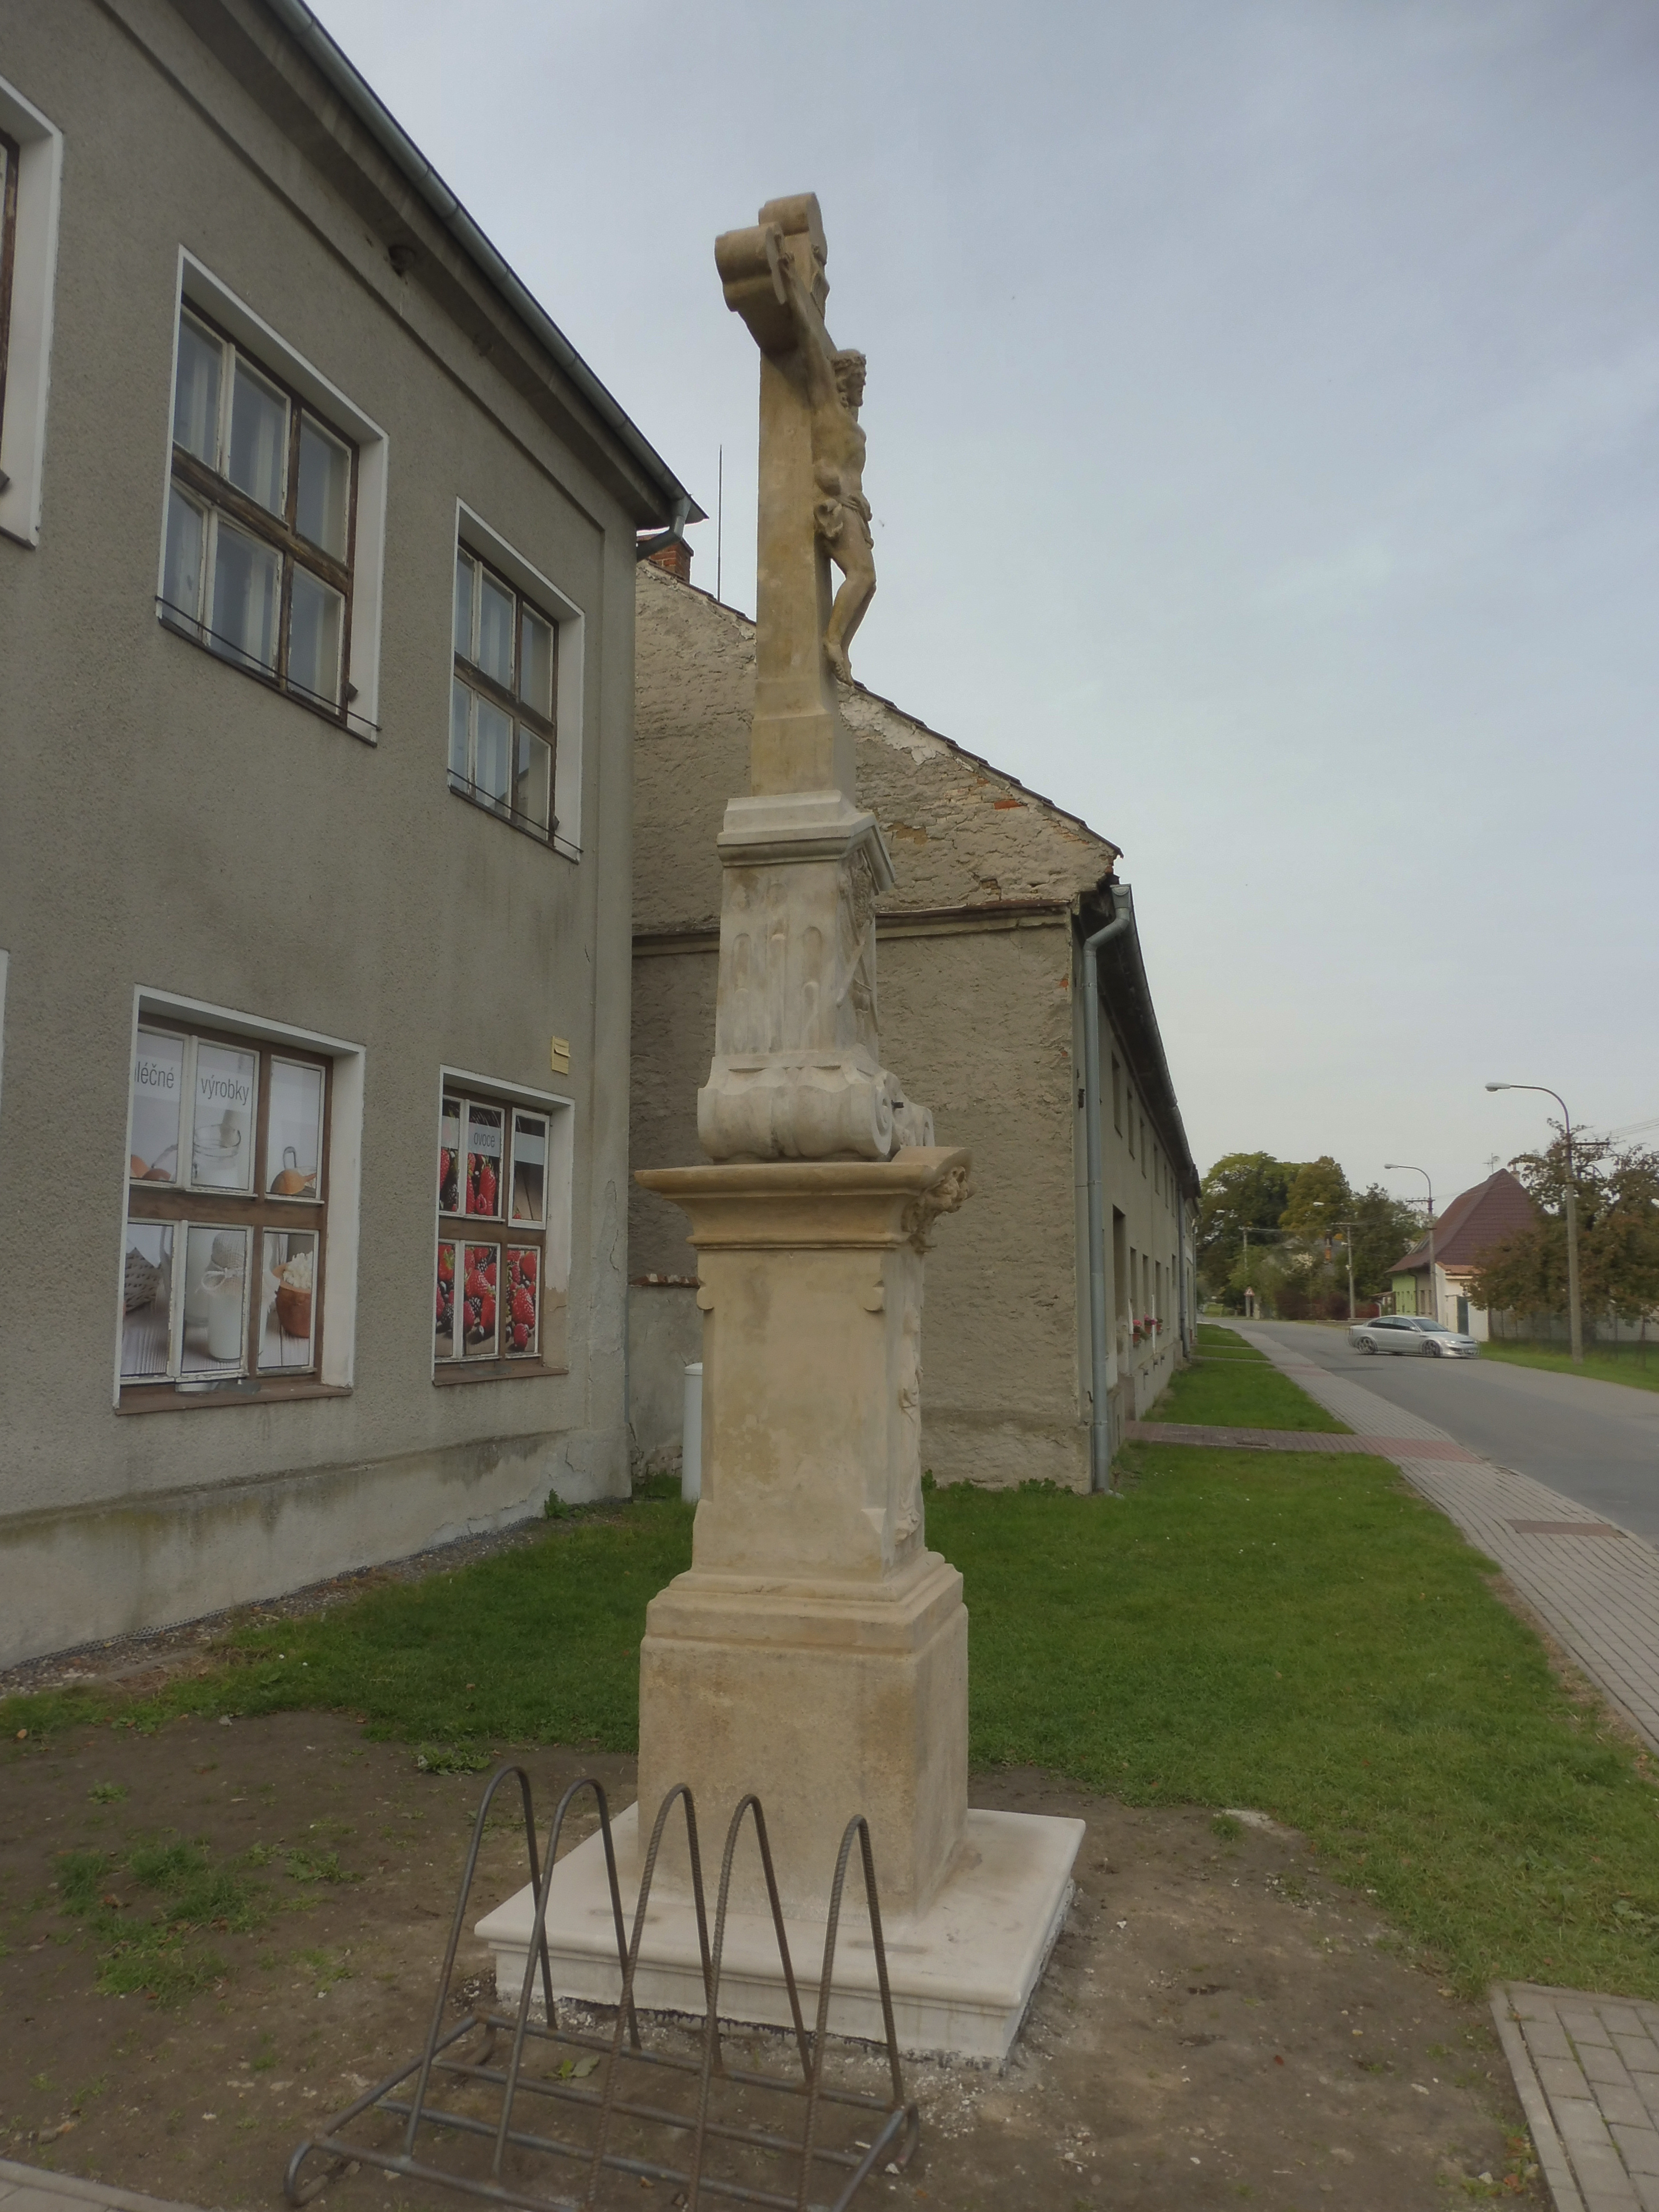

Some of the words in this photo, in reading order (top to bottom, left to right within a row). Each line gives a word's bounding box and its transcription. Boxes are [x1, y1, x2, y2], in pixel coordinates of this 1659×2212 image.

[134, 1061, 174, 1088] léčné
[201, 1075, 249, 1106] výrobky
[474, 1132, 495, 1148] ovoce
